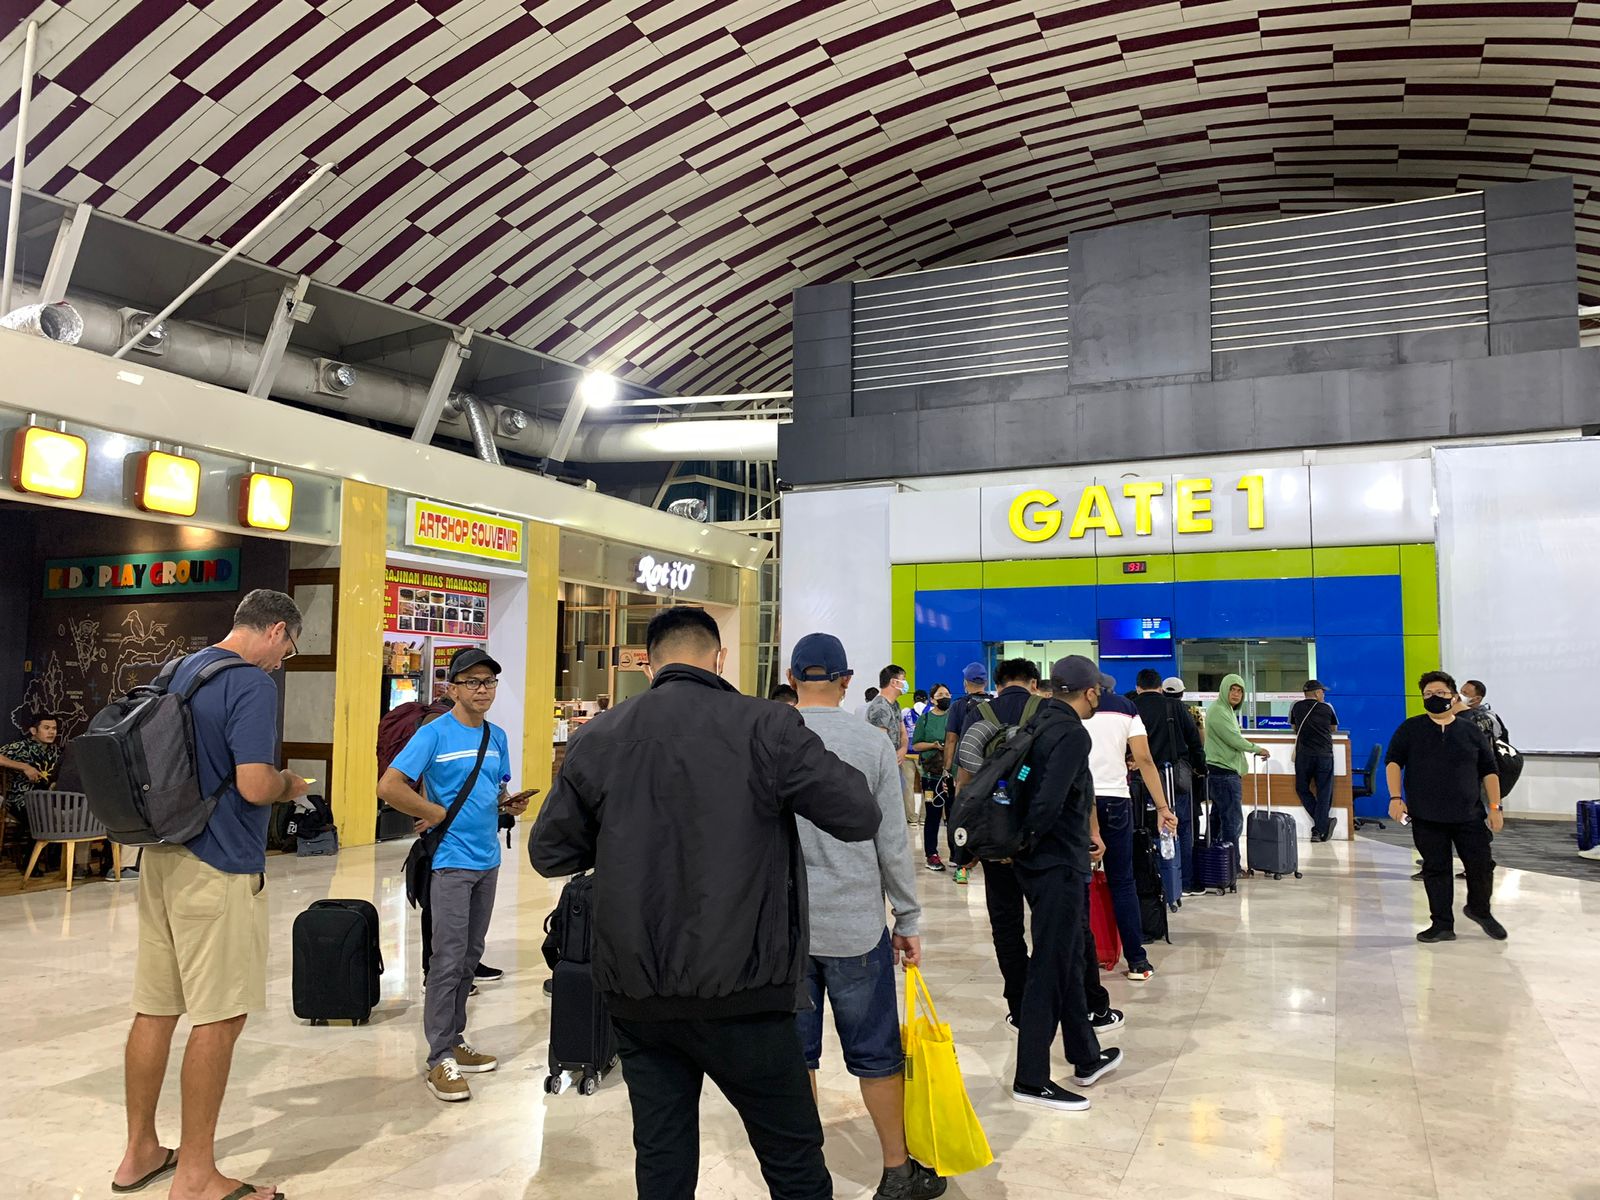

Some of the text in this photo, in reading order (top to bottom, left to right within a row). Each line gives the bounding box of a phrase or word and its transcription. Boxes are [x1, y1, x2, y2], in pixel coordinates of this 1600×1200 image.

[1008, 475, 1264, 542] GATE 1
[418, 511, 518, 553] ARTSHOP SOUVENIR
[98, 563, 147, 588] PLAY
[149, 559, 233, 585] GROUND
[384, 569, 488, 594] RAJINAN KHAS MAKASSAR
